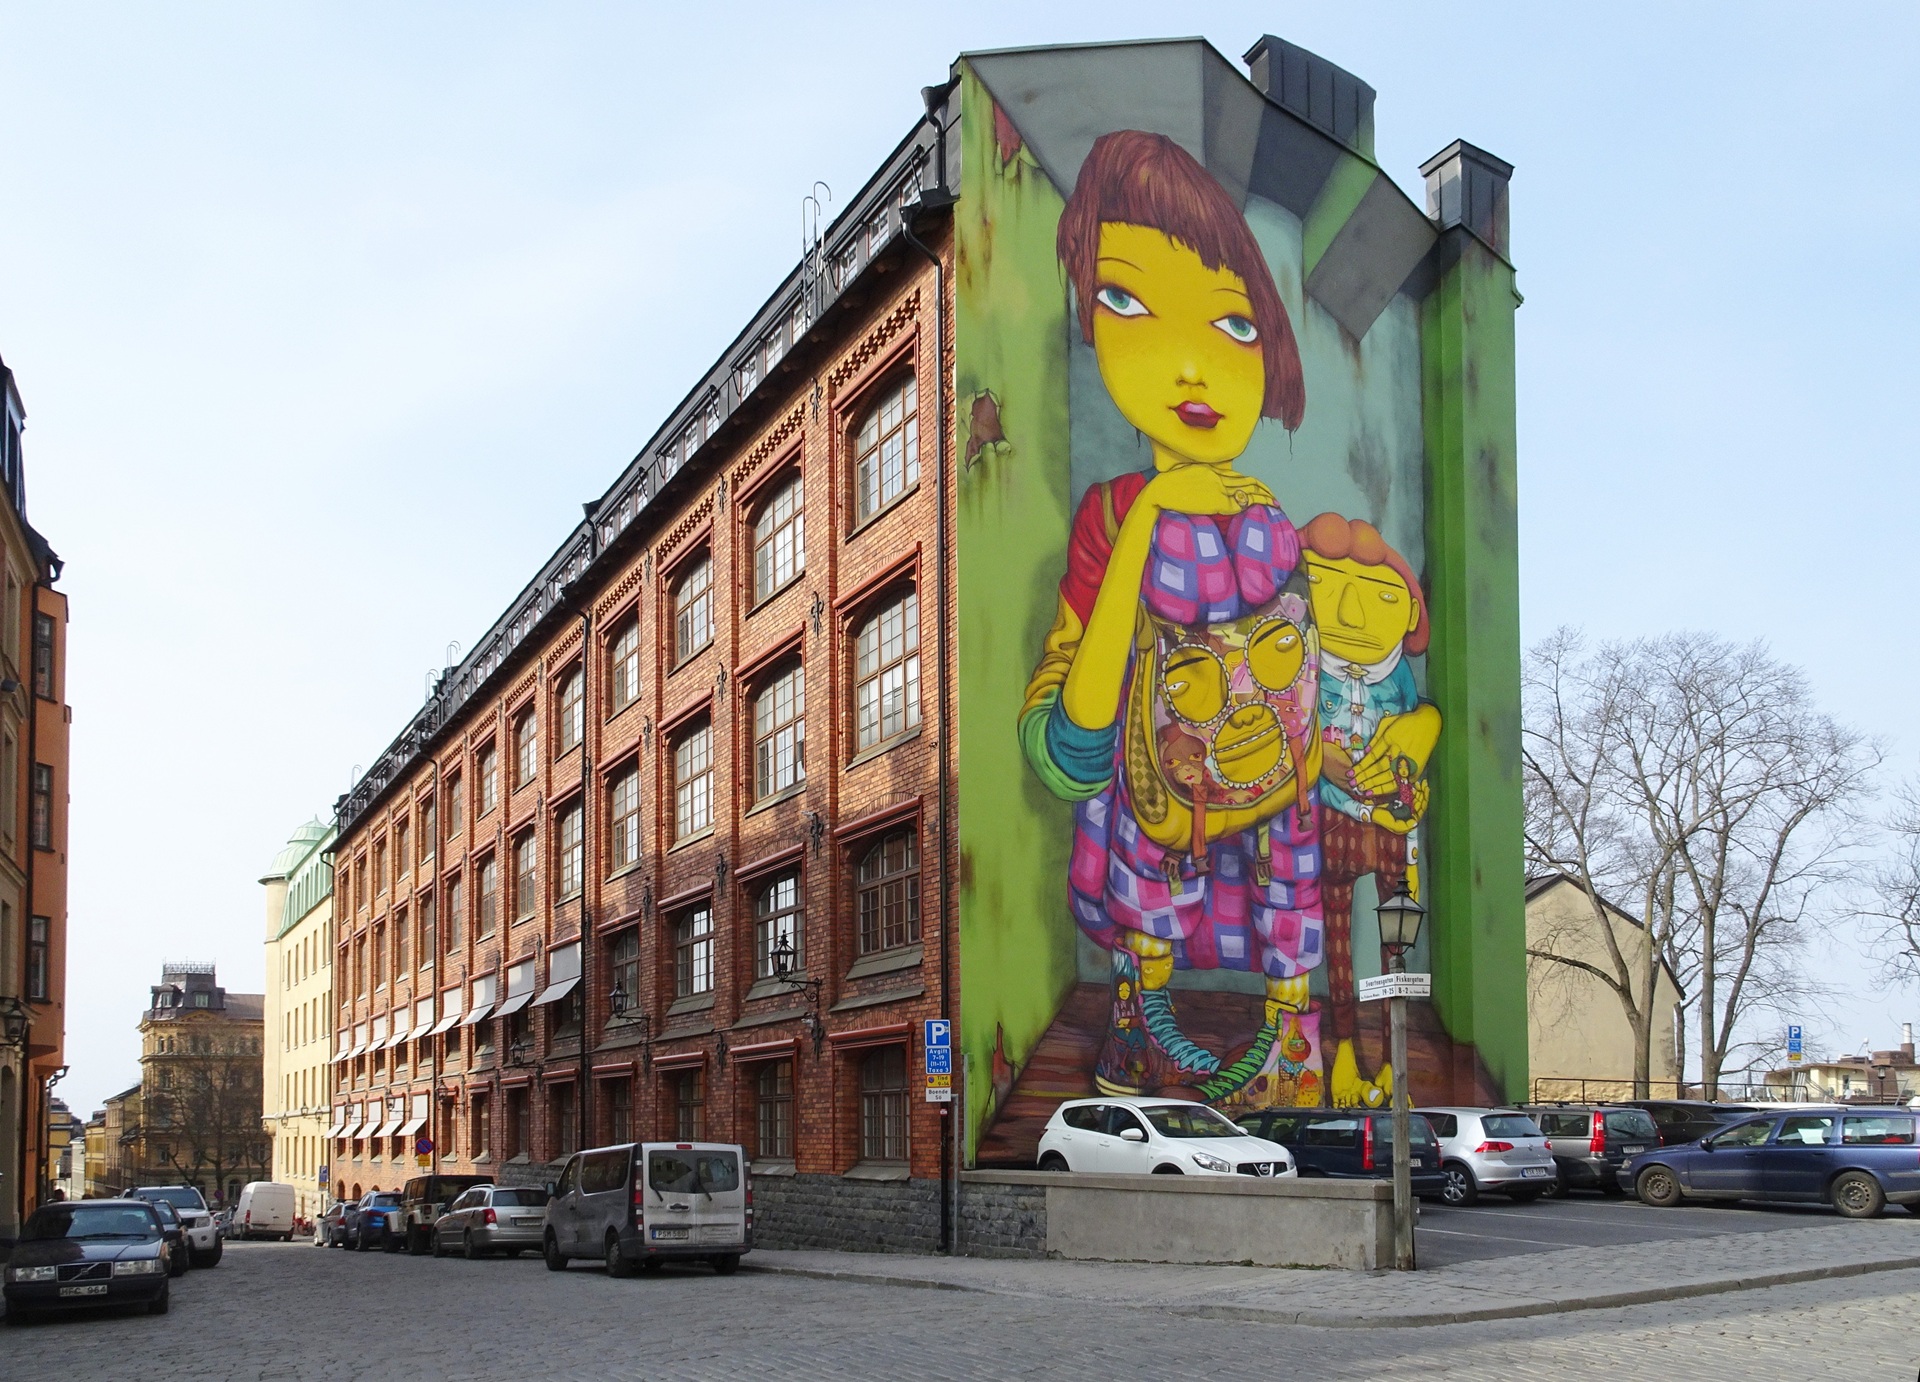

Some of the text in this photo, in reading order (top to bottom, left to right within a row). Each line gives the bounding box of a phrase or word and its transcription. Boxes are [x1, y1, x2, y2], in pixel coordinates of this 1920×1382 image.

[1396, 975, 1424, 984] Fiskargatan
[932, 1022, 945, 1044] P
[1791, 1026, 1800, 1038] P
